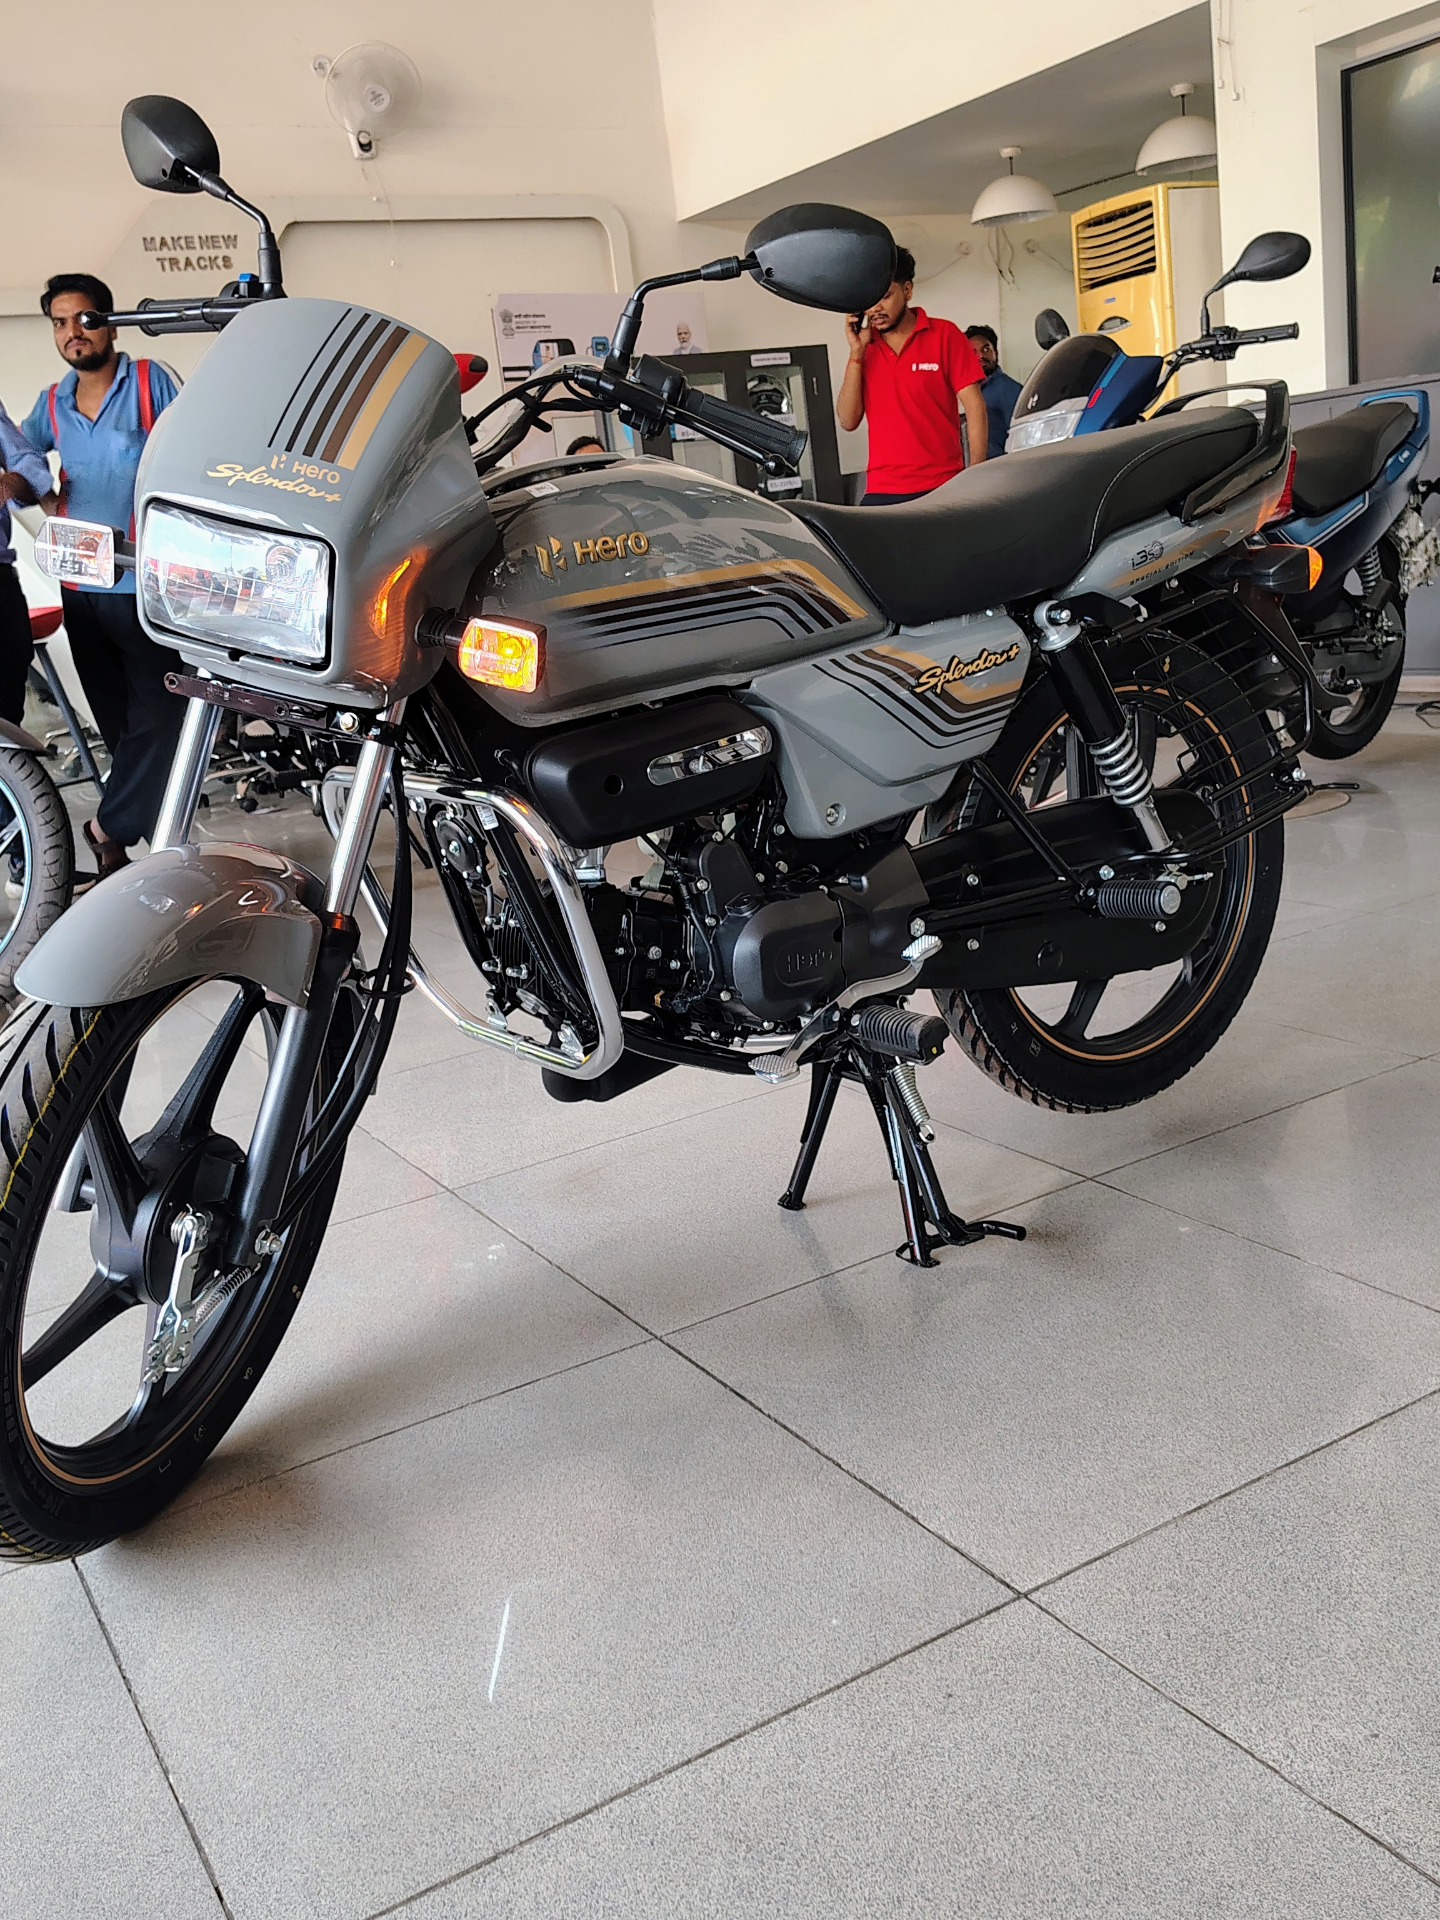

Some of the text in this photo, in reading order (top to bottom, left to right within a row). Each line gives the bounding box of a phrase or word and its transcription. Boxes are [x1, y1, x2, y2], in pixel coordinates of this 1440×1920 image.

[142, 234, 238, 252] MAKE NEW
[156, 255, 234, 272] TRACKS
[206, 463, 342, 503] Splendor+
[291, 460, 341, 485] Hero
[572, 530, 650, 565] Hero
[1129, 550, 1195, 586] SPECIAL EDITION
[911, 642, 1021, 695] Splendor+
